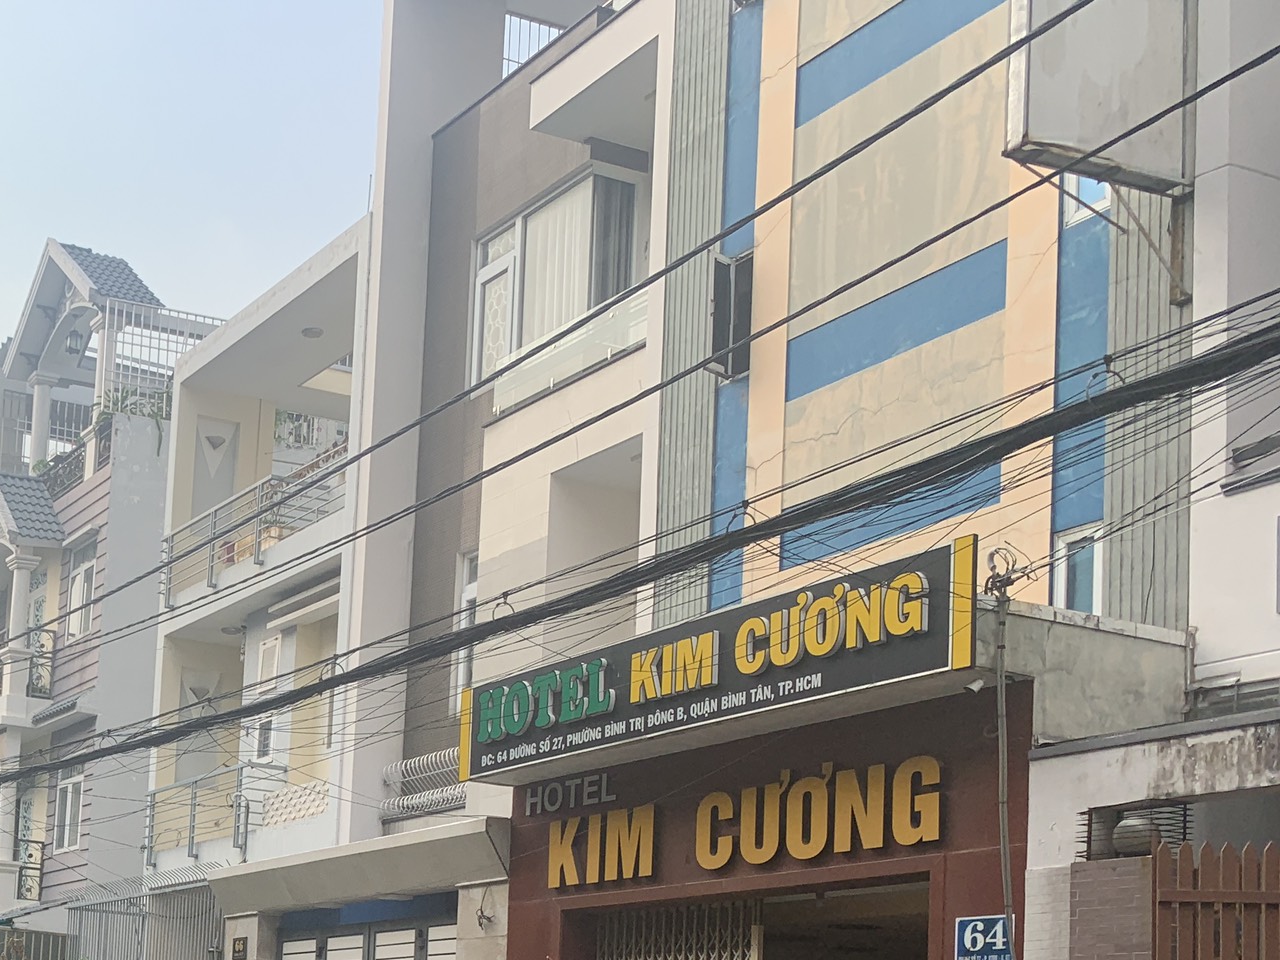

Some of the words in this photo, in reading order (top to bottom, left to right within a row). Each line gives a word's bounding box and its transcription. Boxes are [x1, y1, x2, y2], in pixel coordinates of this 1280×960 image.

[477, 658, 616, 743] HOTEL
[629, 630, 719, 704] KIM
[735, 571, 930, 675] CƯƠNG
[481, 755, 495, 767] ĐC:
[497, 751, 508, 763] 64
[509, 742, 537, 761] ĐƯỜNG
[539, 735, 551, 753] SỐ
[552, 737, 565, 751] 27,
[566, 727, 602, 747] PHƯỜNG
[605, 720, 626, 738] BÌNH
[629, 717, 644, 732] TRỊ
[647, 709, 675, 728] ĐÔNG
[676, 706, 687, 721] B,
[690, 697, 718, 717] QUẬN
[721, 691, 746, 710] BÌNH
[749, 684, 775, 703] TÂN,
[525, 772, 617, 817] HOTEL
[547, 802, 655, 889] KIM
[695, 755, 942, 870] CƯƠNG
[234, 940, 244, 952] 66
[963, 920, 1007, 951] 64
